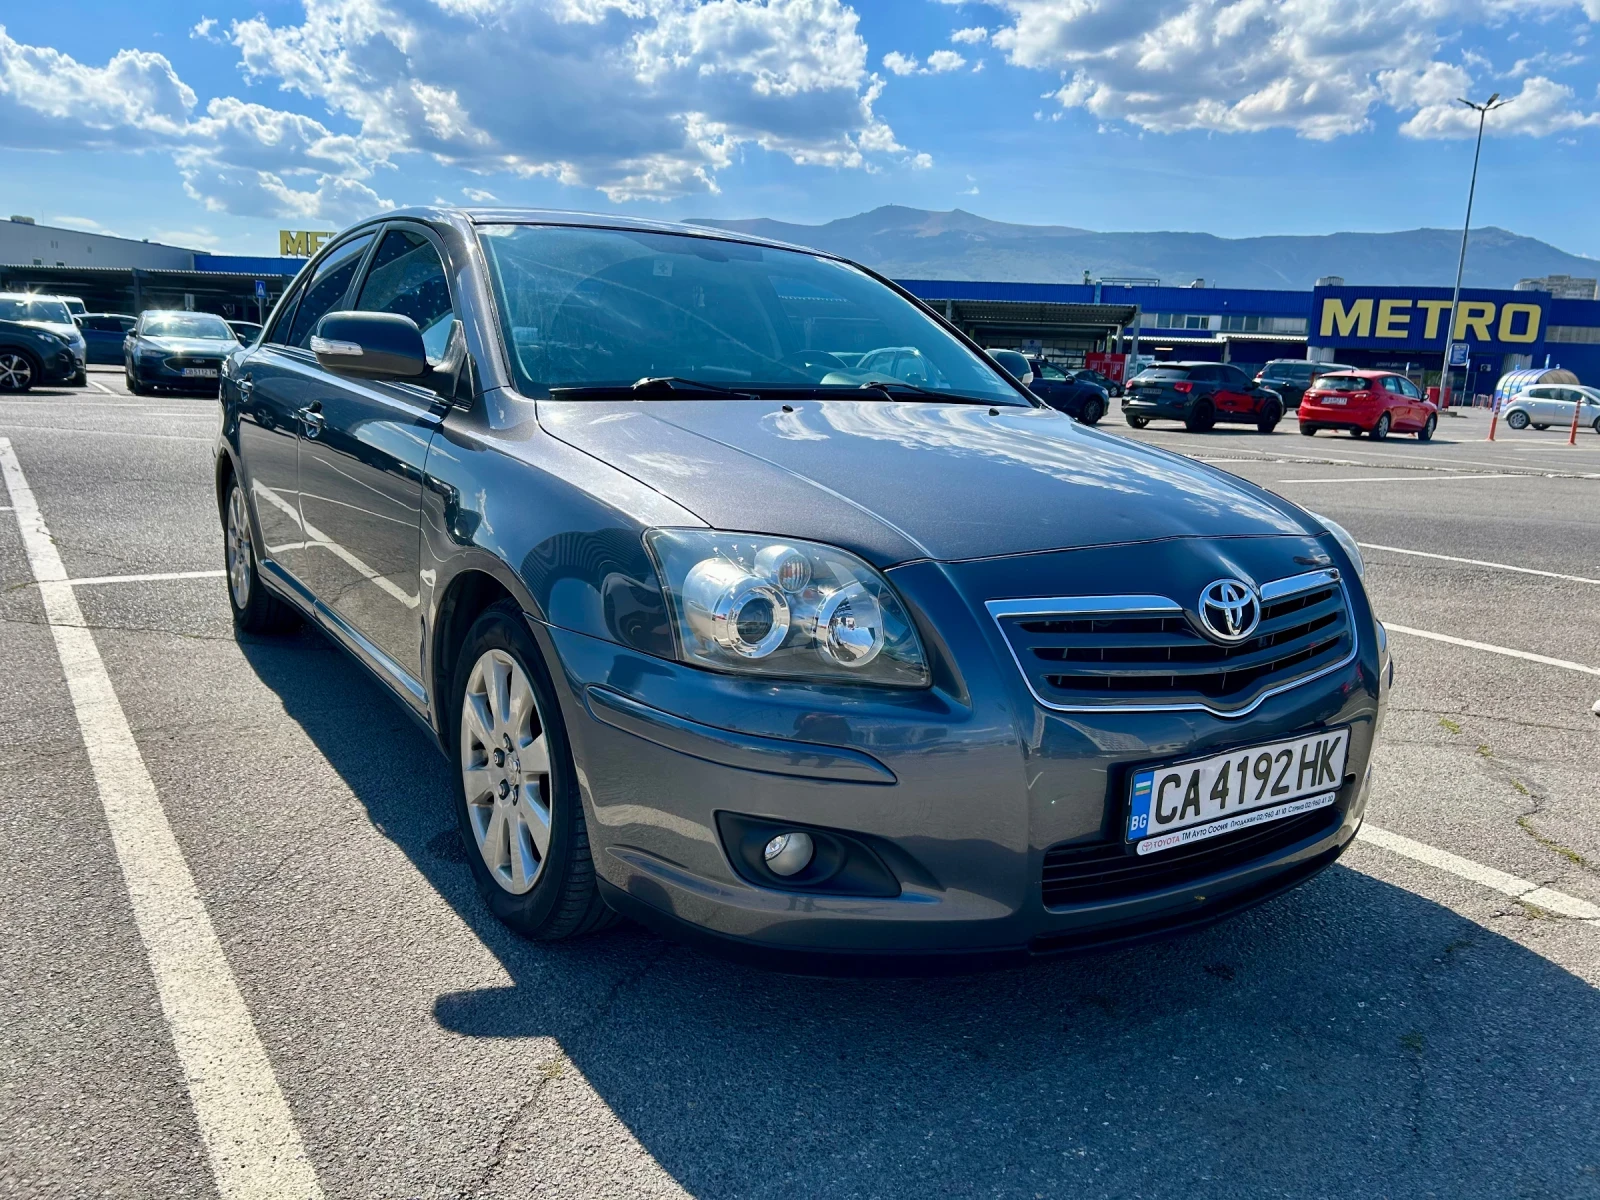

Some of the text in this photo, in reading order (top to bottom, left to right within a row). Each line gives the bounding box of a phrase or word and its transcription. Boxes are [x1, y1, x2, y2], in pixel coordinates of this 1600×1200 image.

[280, 230, 337, 256] ME
[1320, 298, 1542, 343] METRO
[1155, 736, 1342, 824] CA 4192 HK
[1131, 814, 1147, 831] BG
[1153, 835, 1180, 849] TOYOTA
